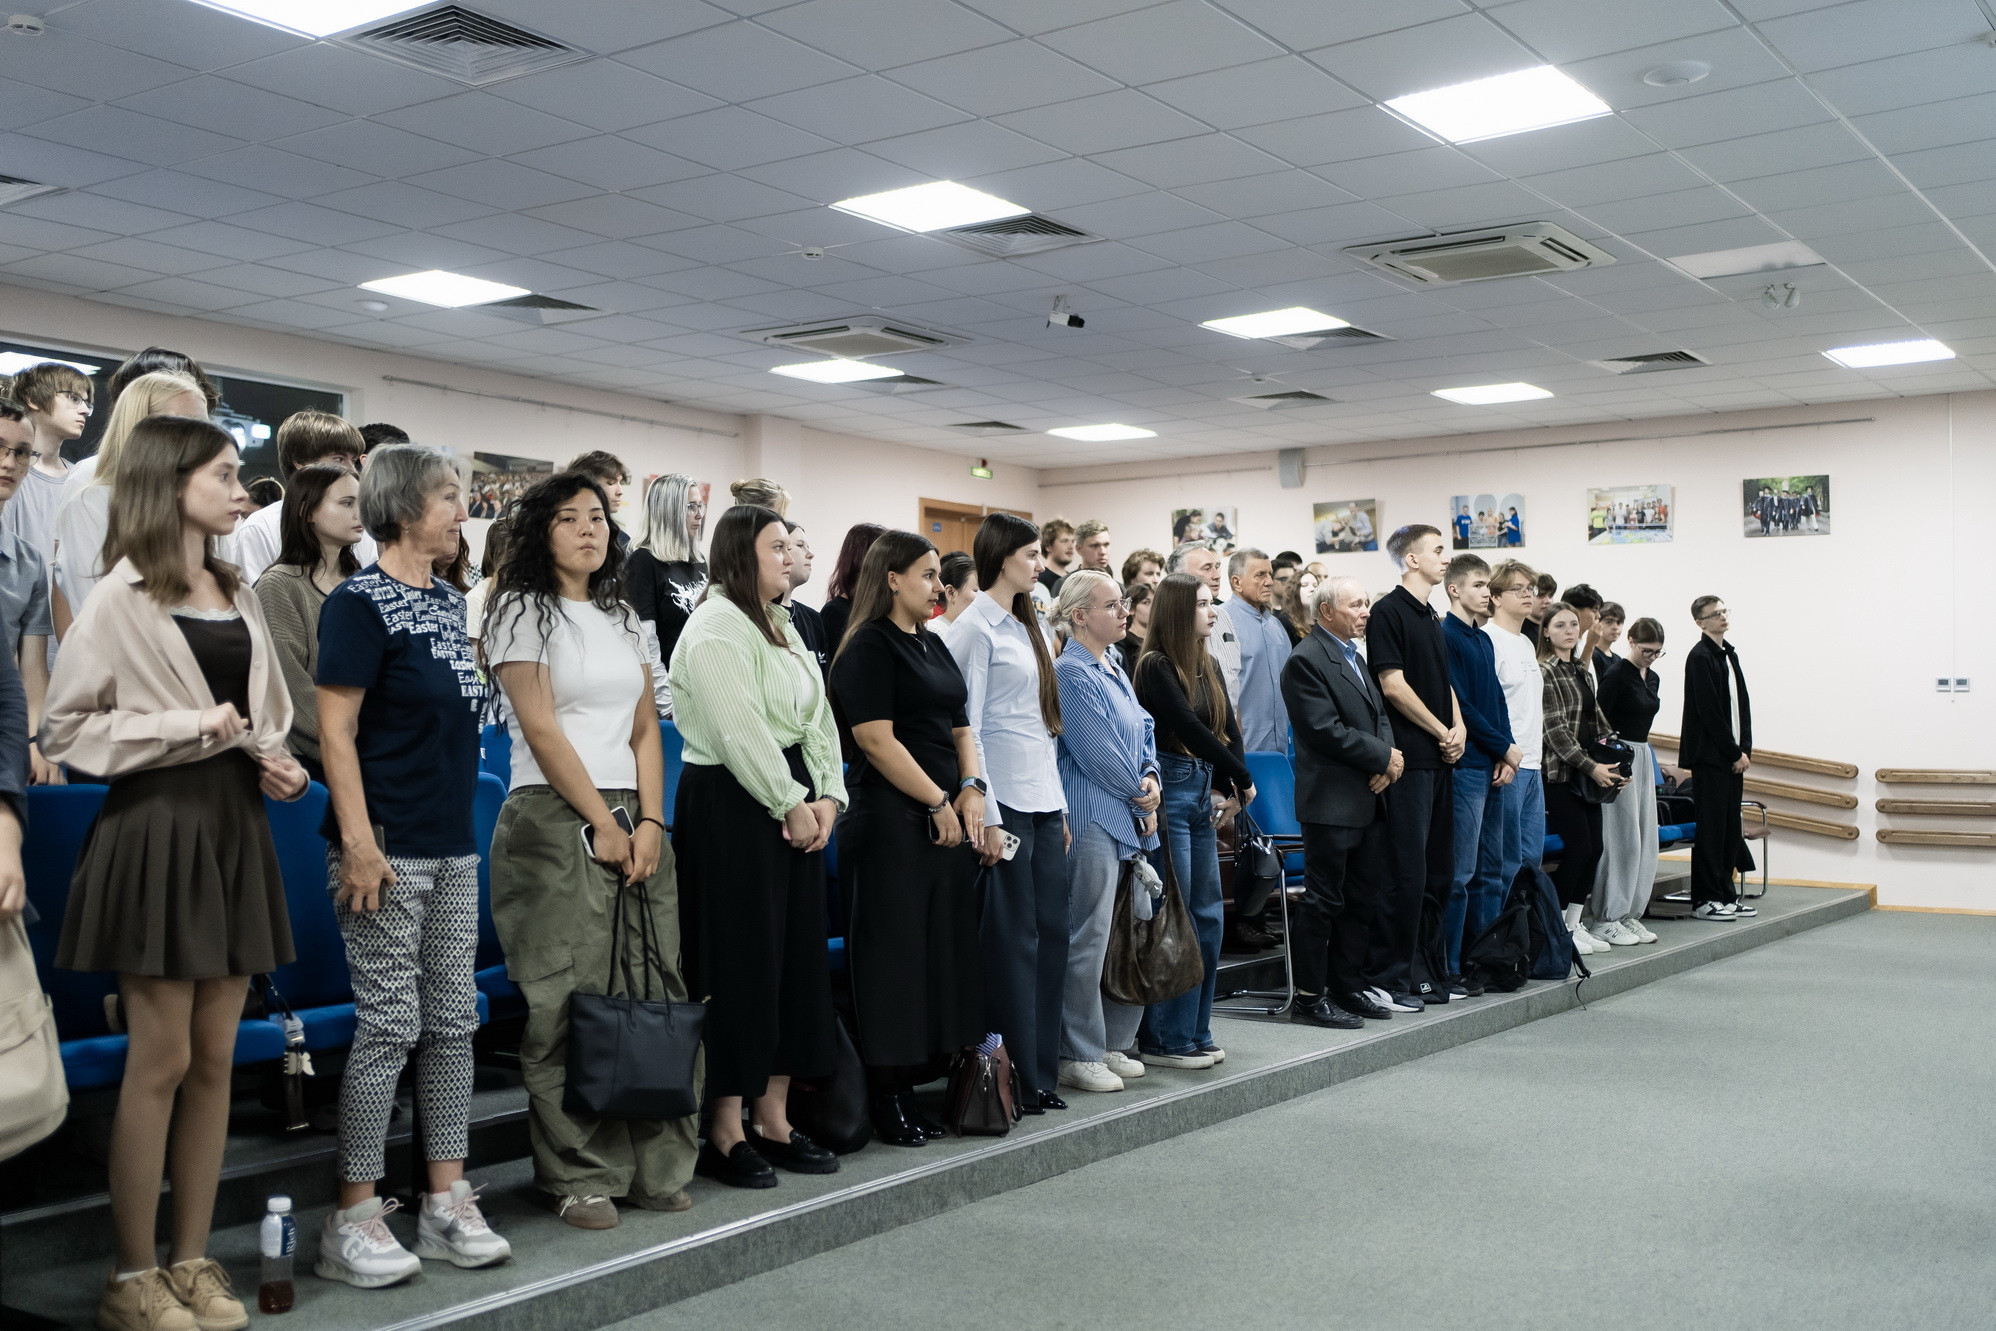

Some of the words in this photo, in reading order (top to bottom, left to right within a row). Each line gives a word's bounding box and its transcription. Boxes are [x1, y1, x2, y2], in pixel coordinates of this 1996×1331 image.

[378, 600, 409, 614] Easter
[382, 610, 413, 626] Easter
[408, 621, 438, 635] Easter
[430, 637, 461, 651] Easter
